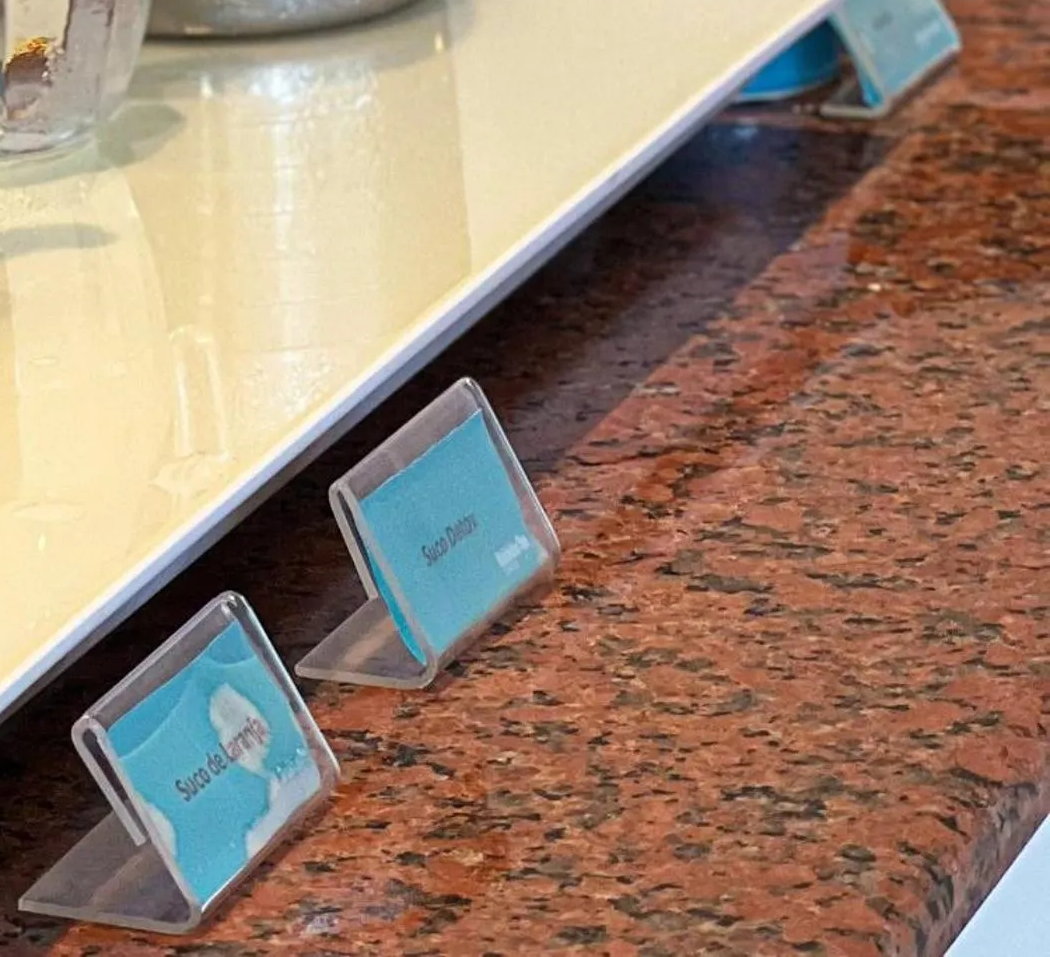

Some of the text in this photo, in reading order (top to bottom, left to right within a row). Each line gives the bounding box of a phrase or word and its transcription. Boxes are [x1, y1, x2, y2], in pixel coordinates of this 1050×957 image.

[175, 716, 267, 802] Suco de Laranja
